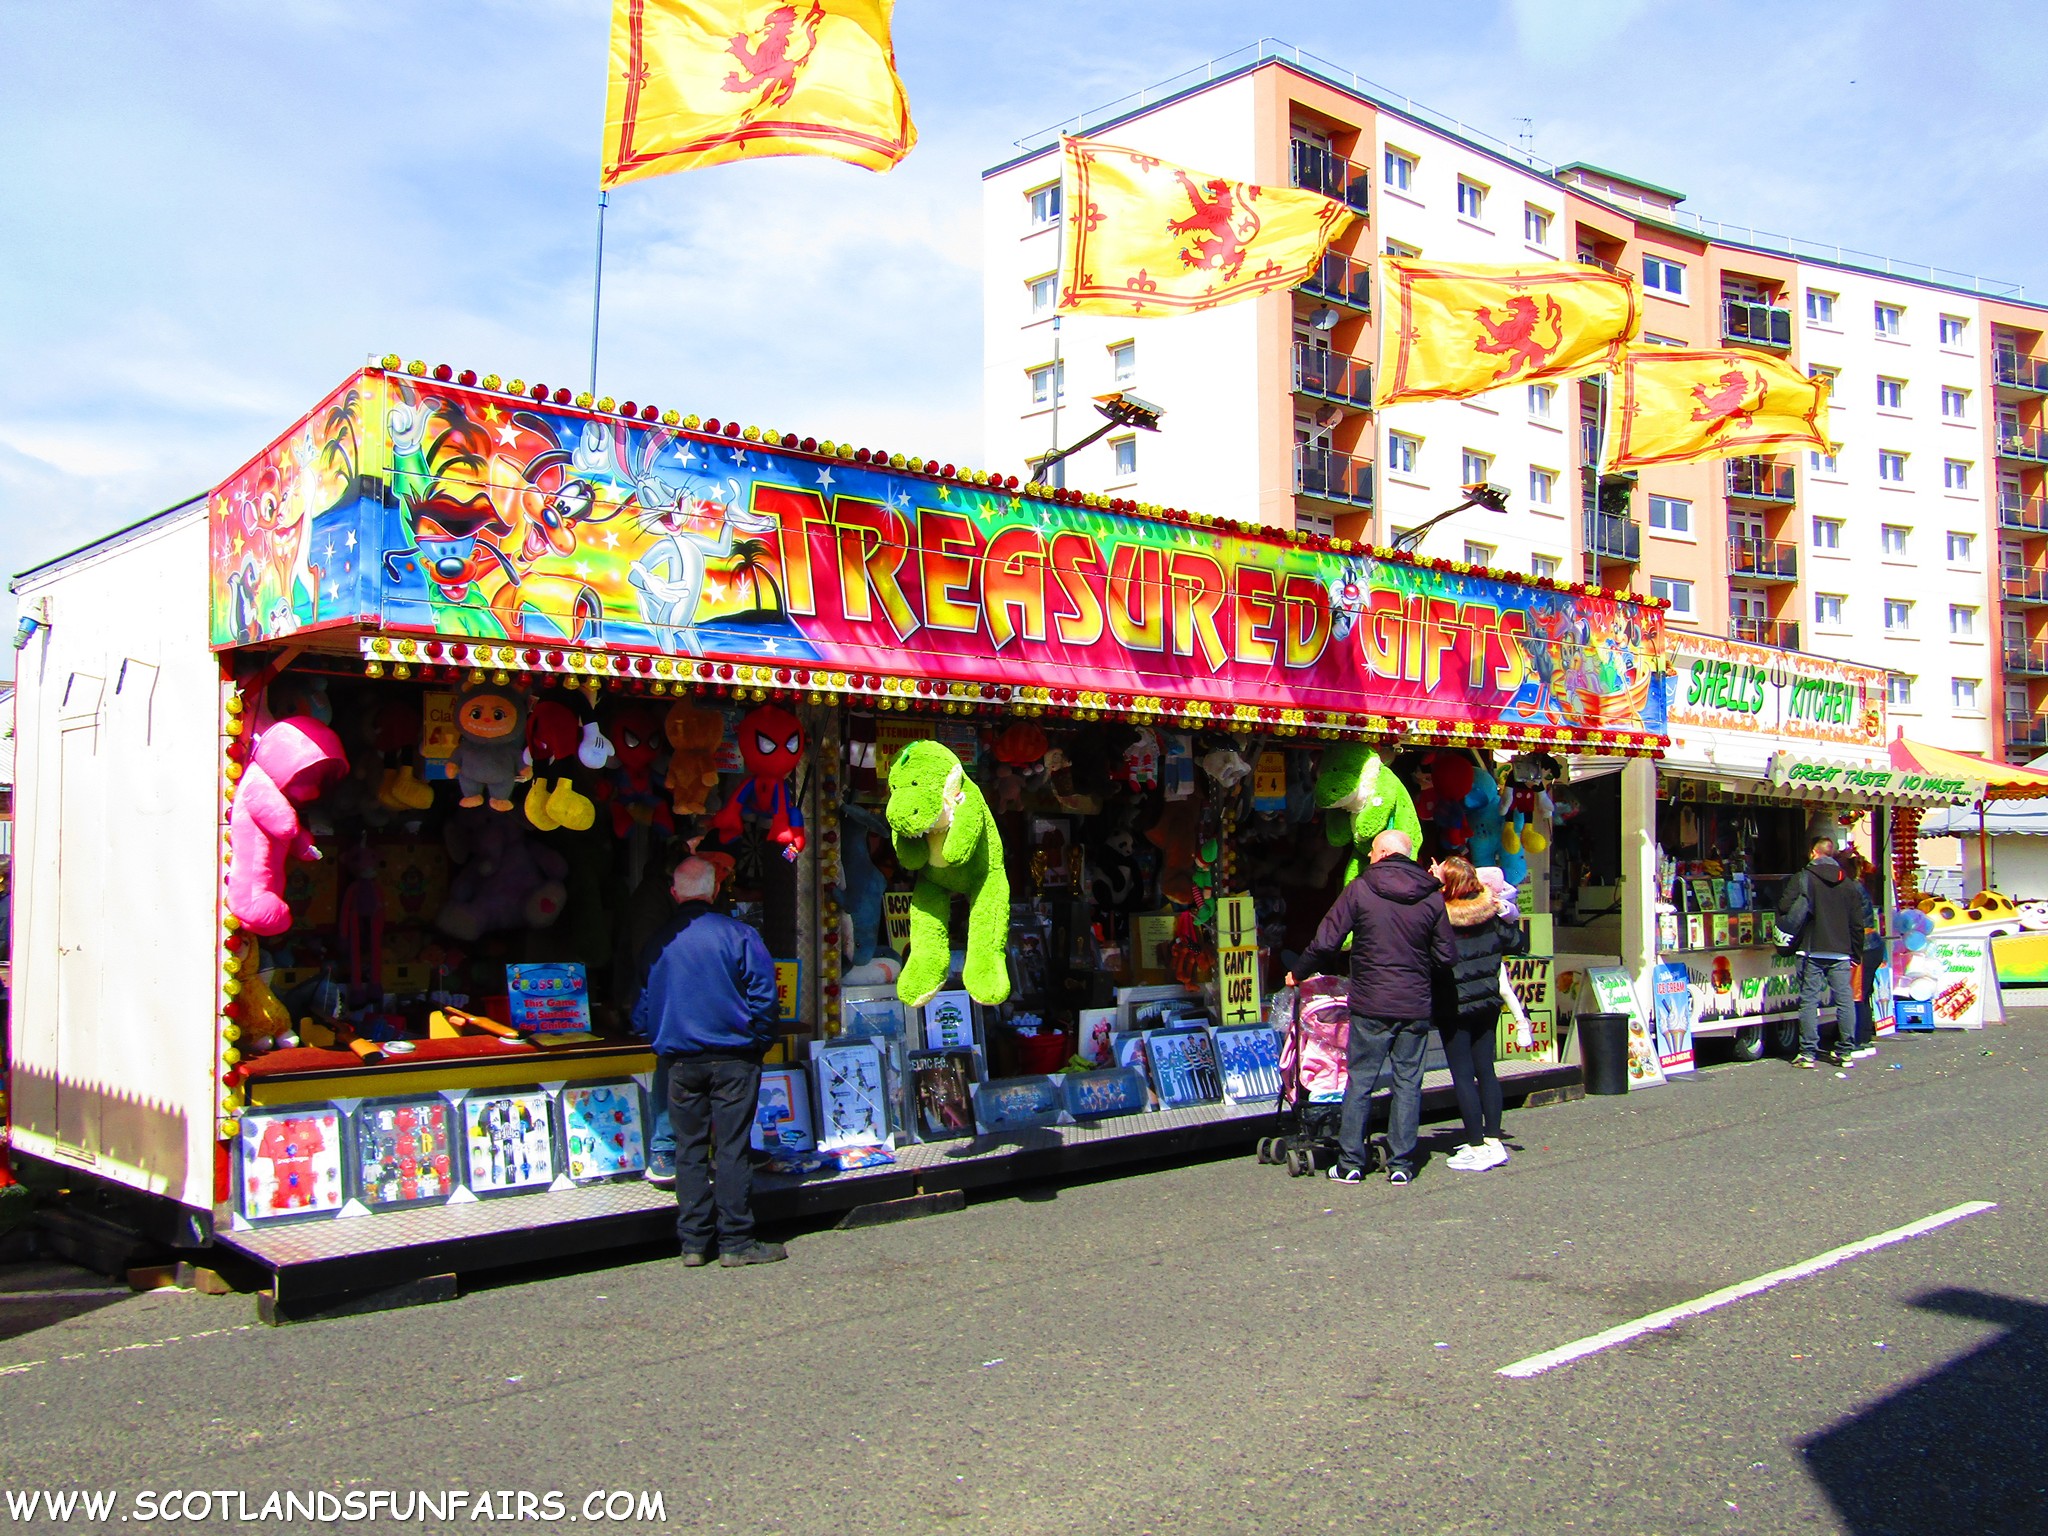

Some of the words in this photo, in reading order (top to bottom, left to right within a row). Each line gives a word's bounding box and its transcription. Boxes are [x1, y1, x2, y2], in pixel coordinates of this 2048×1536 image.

[750, 481, 1334, 673] TREASURED
[1360, 597, 1528, 694] GIFTS
[1687, 659, 1766, 714] SHELL'S
[1788, 674, 1855, 726] KITCHEN
[1788, 763, 1843, 784] GREAT
[1843, 770, 1892, 789] TASTE!
[1898, 775, 1921, 791] NO
[1229, 901, 1242, 947] U
[1224, 950, 1253, 976] CAN'T
[512, 978, 583, 991] CROSSBOW
[1228, 978, 1253, 1004] LOSE
[1658, 983, 1666, 995] ICE
[1666, 981, 1685, 995] CREAM
[1739, 977, 1760, 999] NEW
[1513, 983, 1547, 1004] OSE
[524, 999, 544, 1008] This
[547, 998, 576, 1007] Game
[538, 1010, 579, 1019] Suitable
[942, 1012, 956, 1025] 55
[540, 1020, 585, 1031] Children
[1508, 1021, 1547, 1035] PZE
[1662, 1054, 1677, 1065] SOLD
